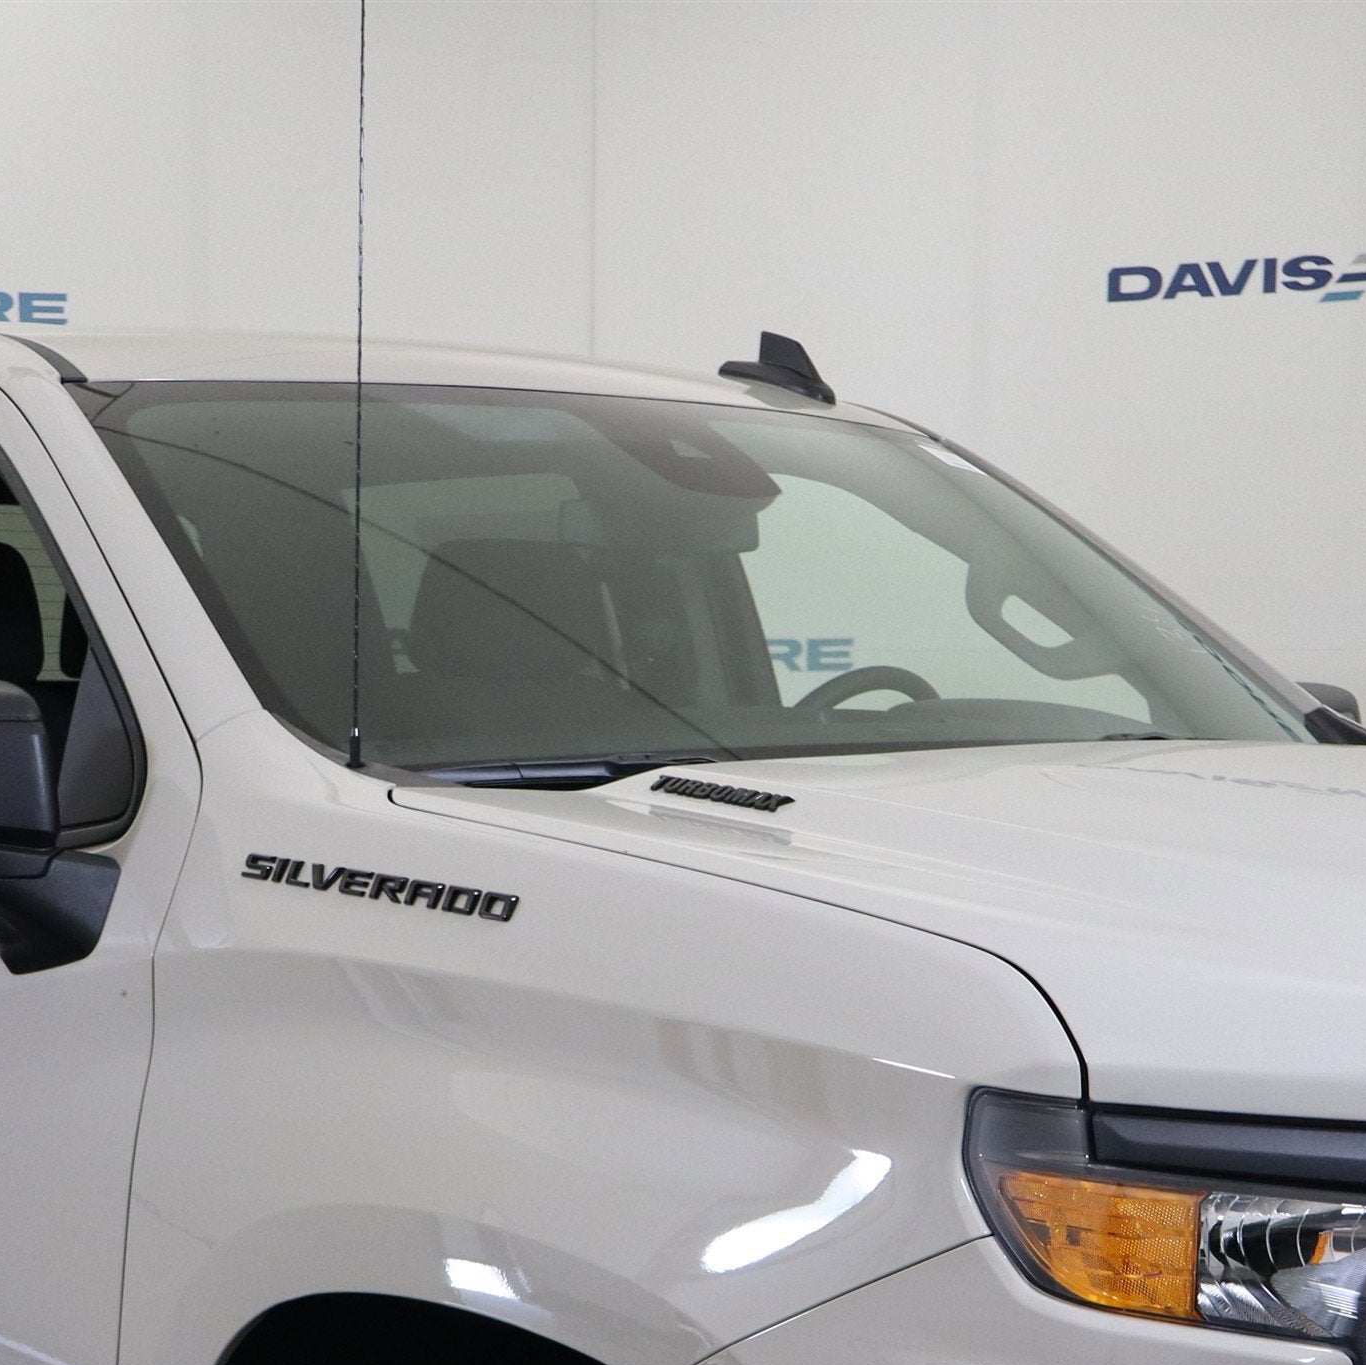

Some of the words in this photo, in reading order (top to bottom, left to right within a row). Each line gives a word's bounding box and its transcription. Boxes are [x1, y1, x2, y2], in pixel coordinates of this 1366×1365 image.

[1107, 254, 1334, 303] DAVIS
[650, 774, 795, 813] TURBOMAX
[241, 852, 521, 923] SILVERADO
